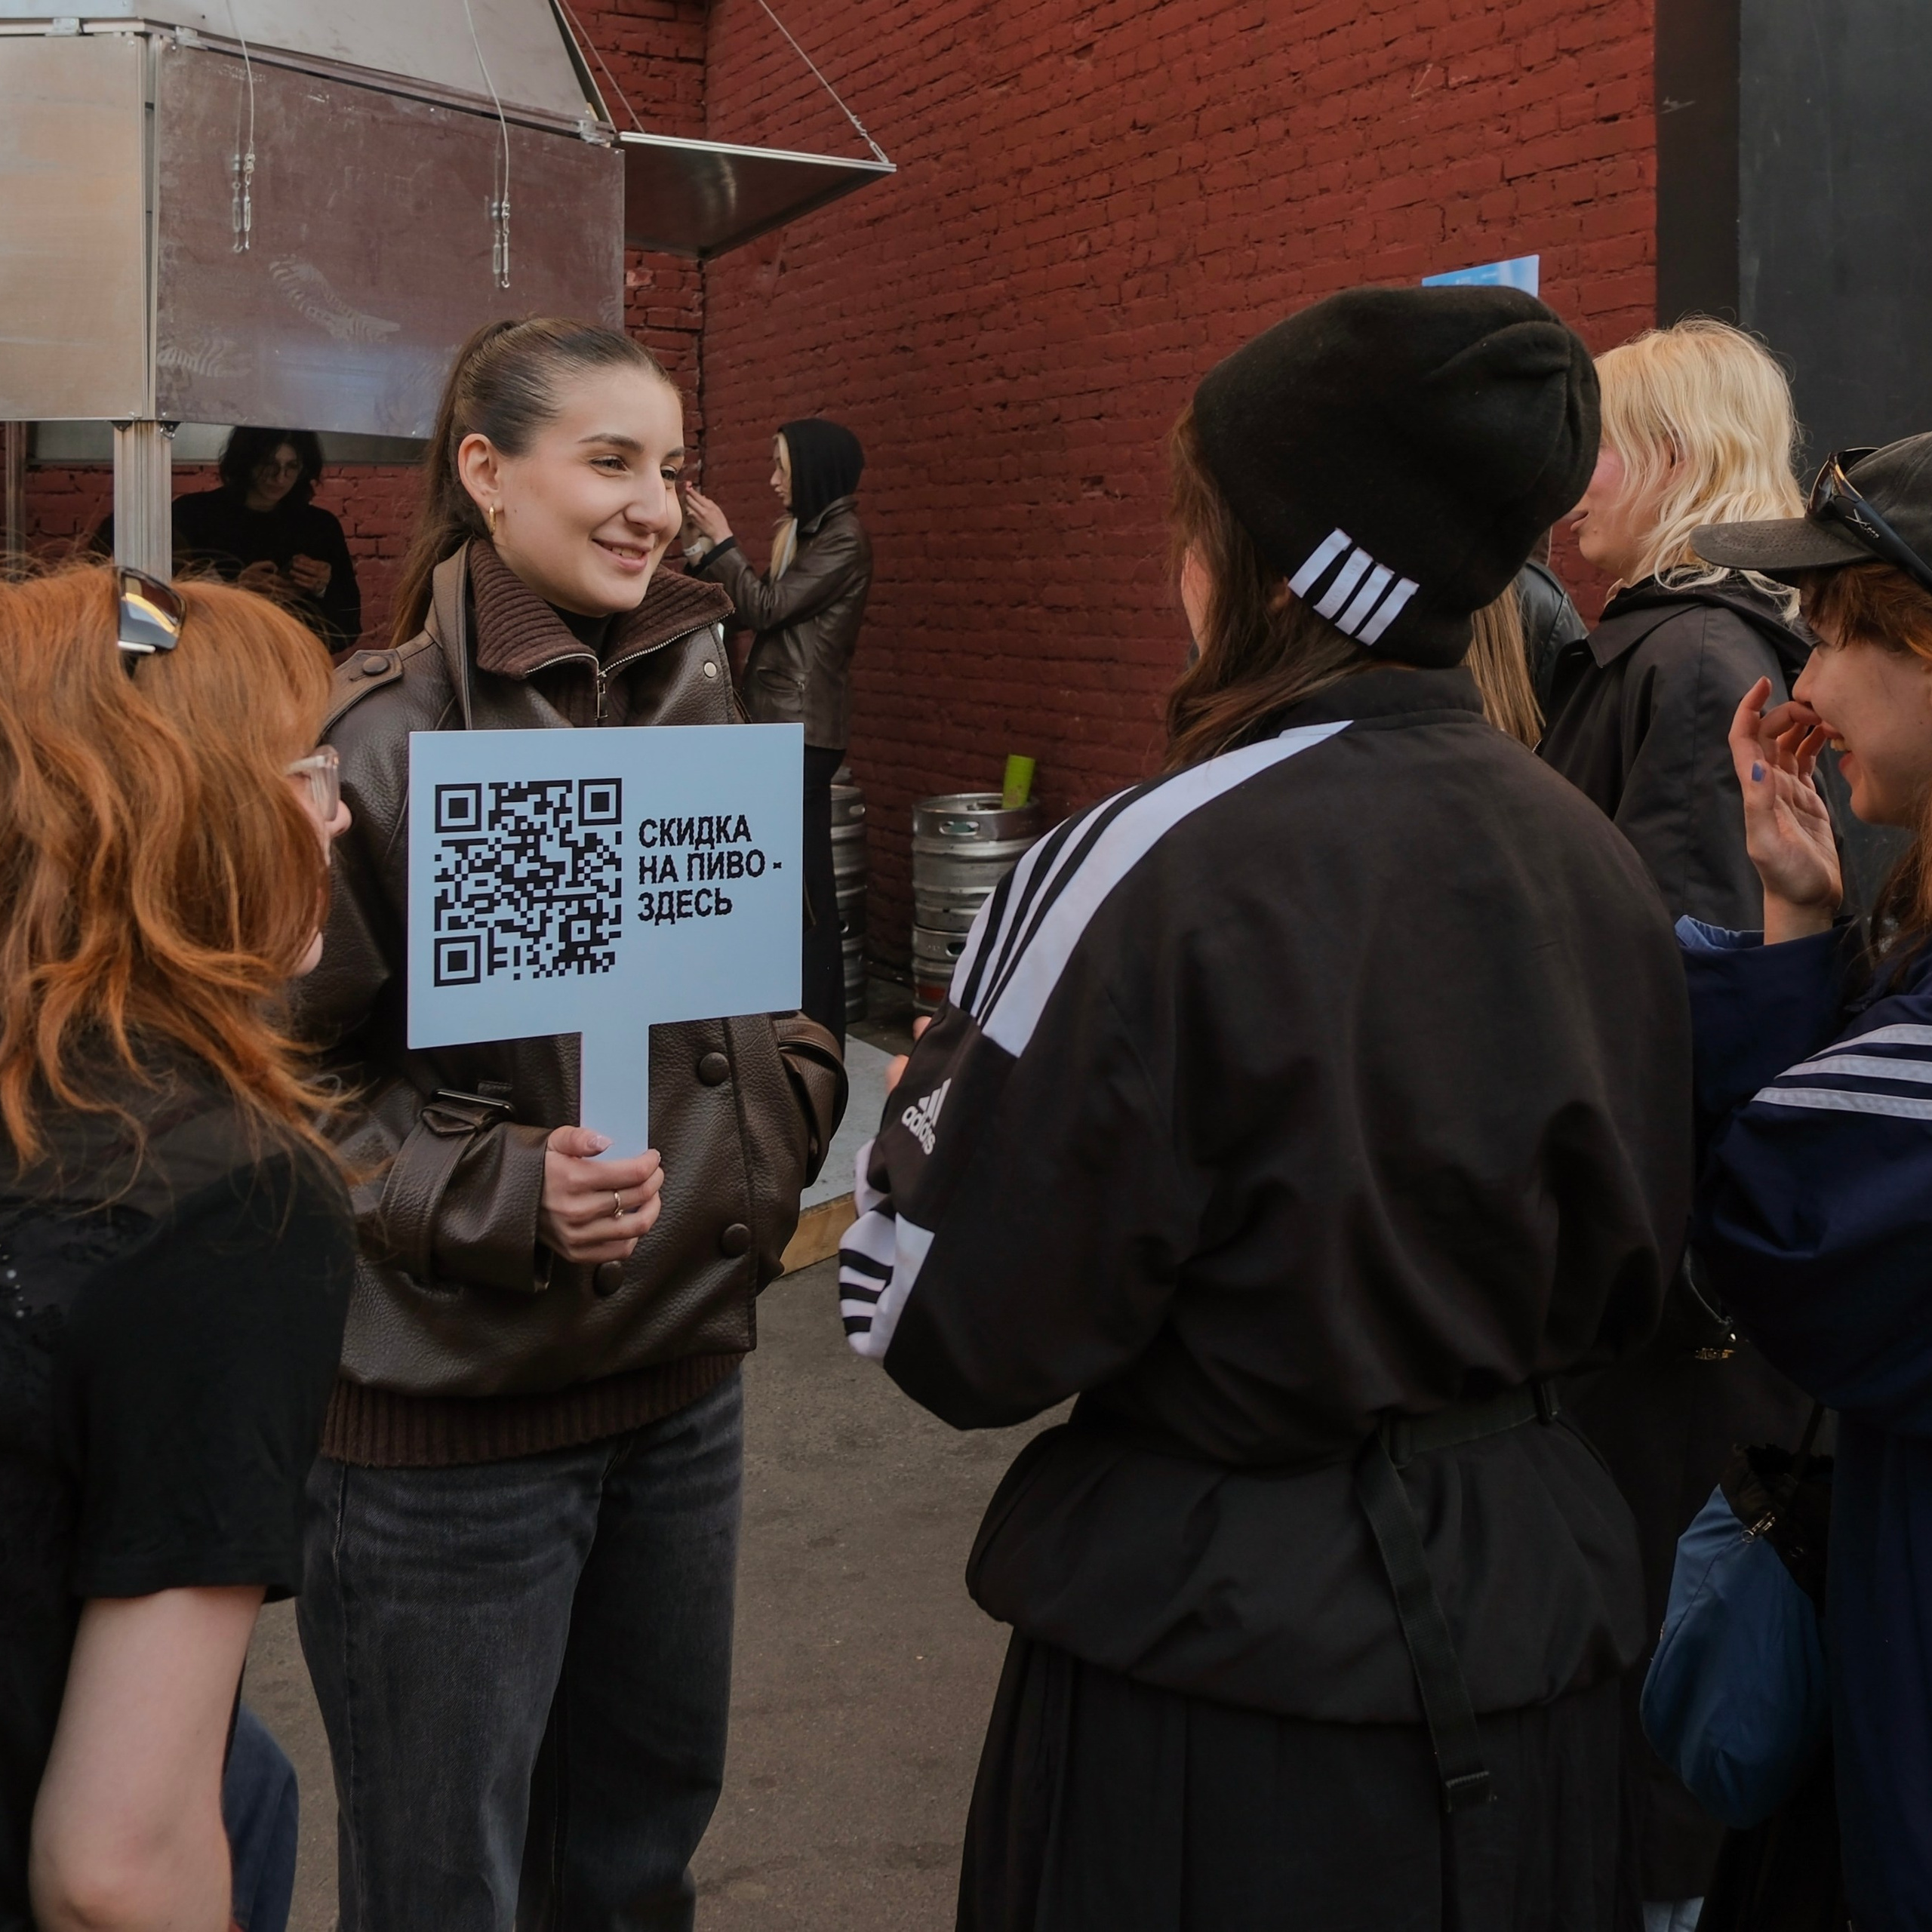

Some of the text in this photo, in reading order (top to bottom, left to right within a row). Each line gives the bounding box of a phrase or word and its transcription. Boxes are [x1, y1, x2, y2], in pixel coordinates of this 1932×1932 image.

[638, 814, 752, 851] СКИДКА
[638, 854, 679, 885] НА
[637, 887, 733, 927] ЗДЕСЬ
